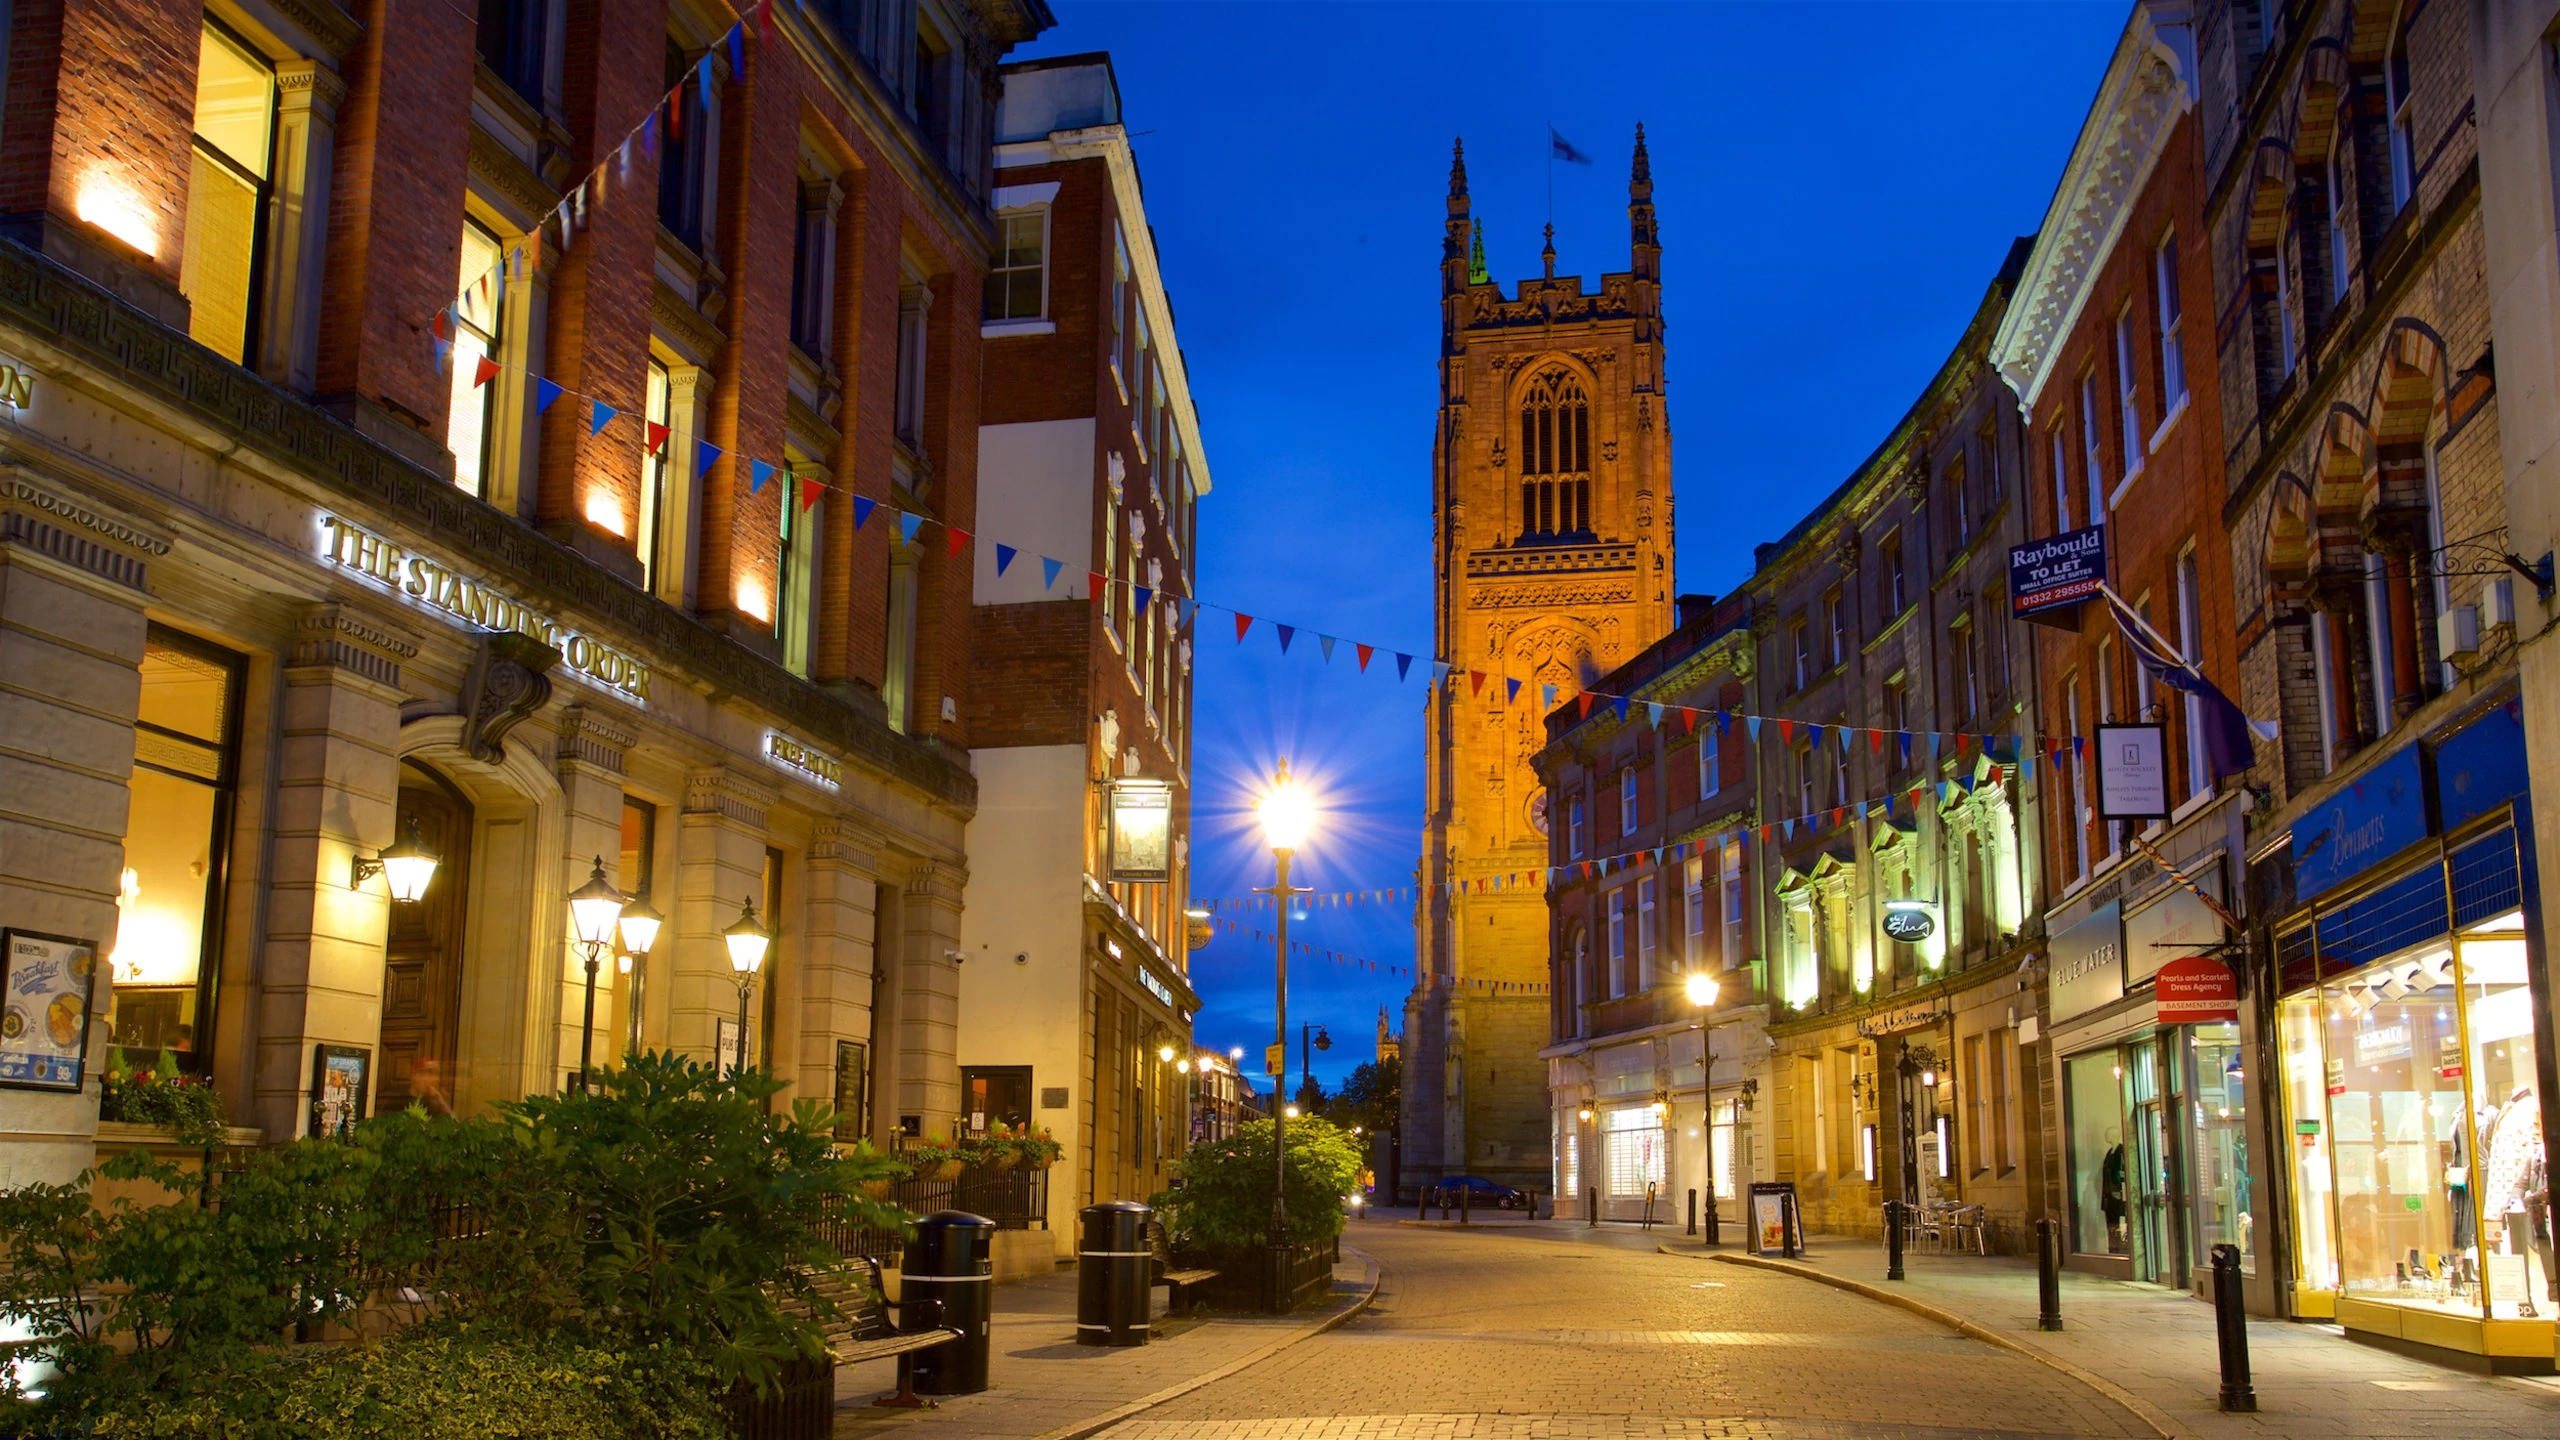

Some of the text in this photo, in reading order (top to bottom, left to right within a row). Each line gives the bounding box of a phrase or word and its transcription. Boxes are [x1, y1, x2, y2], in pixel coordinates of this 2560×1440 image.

[2012, 530, 2100, 568] Raybould
[2081, 547, 2100, 557] Sons
[2029, 559, 2081, 580] TO LET
[2043, 574, 2066, 585] OFFICE
[2068, 568, 2092, 578] SUITES
[2022, 592, 2052, 606] 01332
[2055, 581, 2095, 599] 295555
[324, 516, 651, 701] THE STANDING ORDER
[771, 735, 804, 767] FREE
[2329, 807, 2385, 869] Bennetts
[11, 960, 60, 990] Breakfast
[2055, 943, 2115, 986] BLUE WATER
[2161, 973, 2230, 982] Pearls and Scarlett
[2171, 983, 2222, 993] Dress Agency
[2209, 1001, 2230, 1009] SHOP
[722, 1038, 734, 1051] PUB
[57, 1065, 72, 1081] 99p
